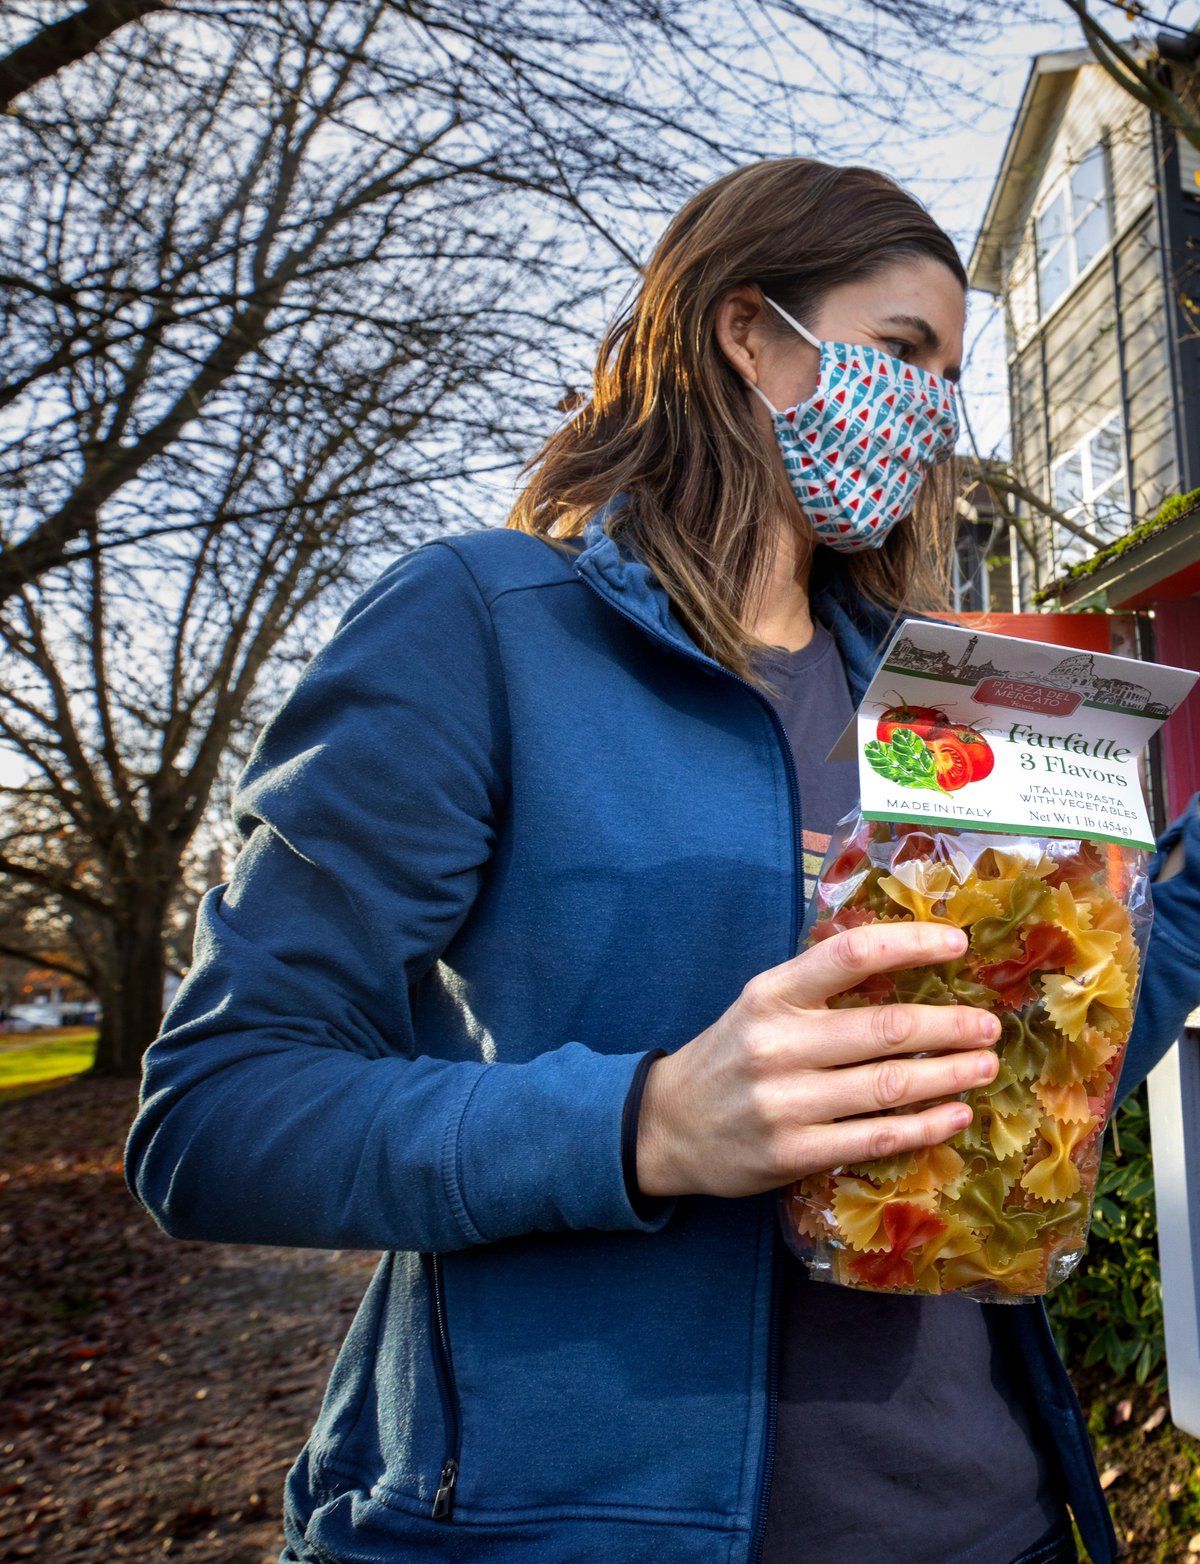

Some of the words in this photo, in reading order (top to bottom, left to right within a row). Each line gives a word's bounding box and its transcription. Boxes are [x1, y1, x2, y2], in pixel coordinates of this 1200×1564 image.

[992, 680, 1042, 696] PIAZZA
[1046, 690, 1071, 702] DEL
[994, 689, 1060, 707] MERCATO
[1005, 722, 1131, 763] Farfalle
[1020, 752, 1036, 770] 3
[1043, 755, 1128, 787] Flavors
[1020, 794, 1055, 805] WITH
[1059, 797, 1138, 820] VEGETABLES
[1029, 784, 1083, 799] ITALIAN
[1086, 792, 1125, 807] PASTA
[887, 799, 930, 812] MADE
[934, 803, 948, 813] IN
[952, 806, 992, 818] ITALY
[1029, 810, 1050, 822] Net
[1053, 812, 1070, 825] Wt
[1084, 816, 1095, 827] lb
[1098, 820, 1132, 837] (454g)
